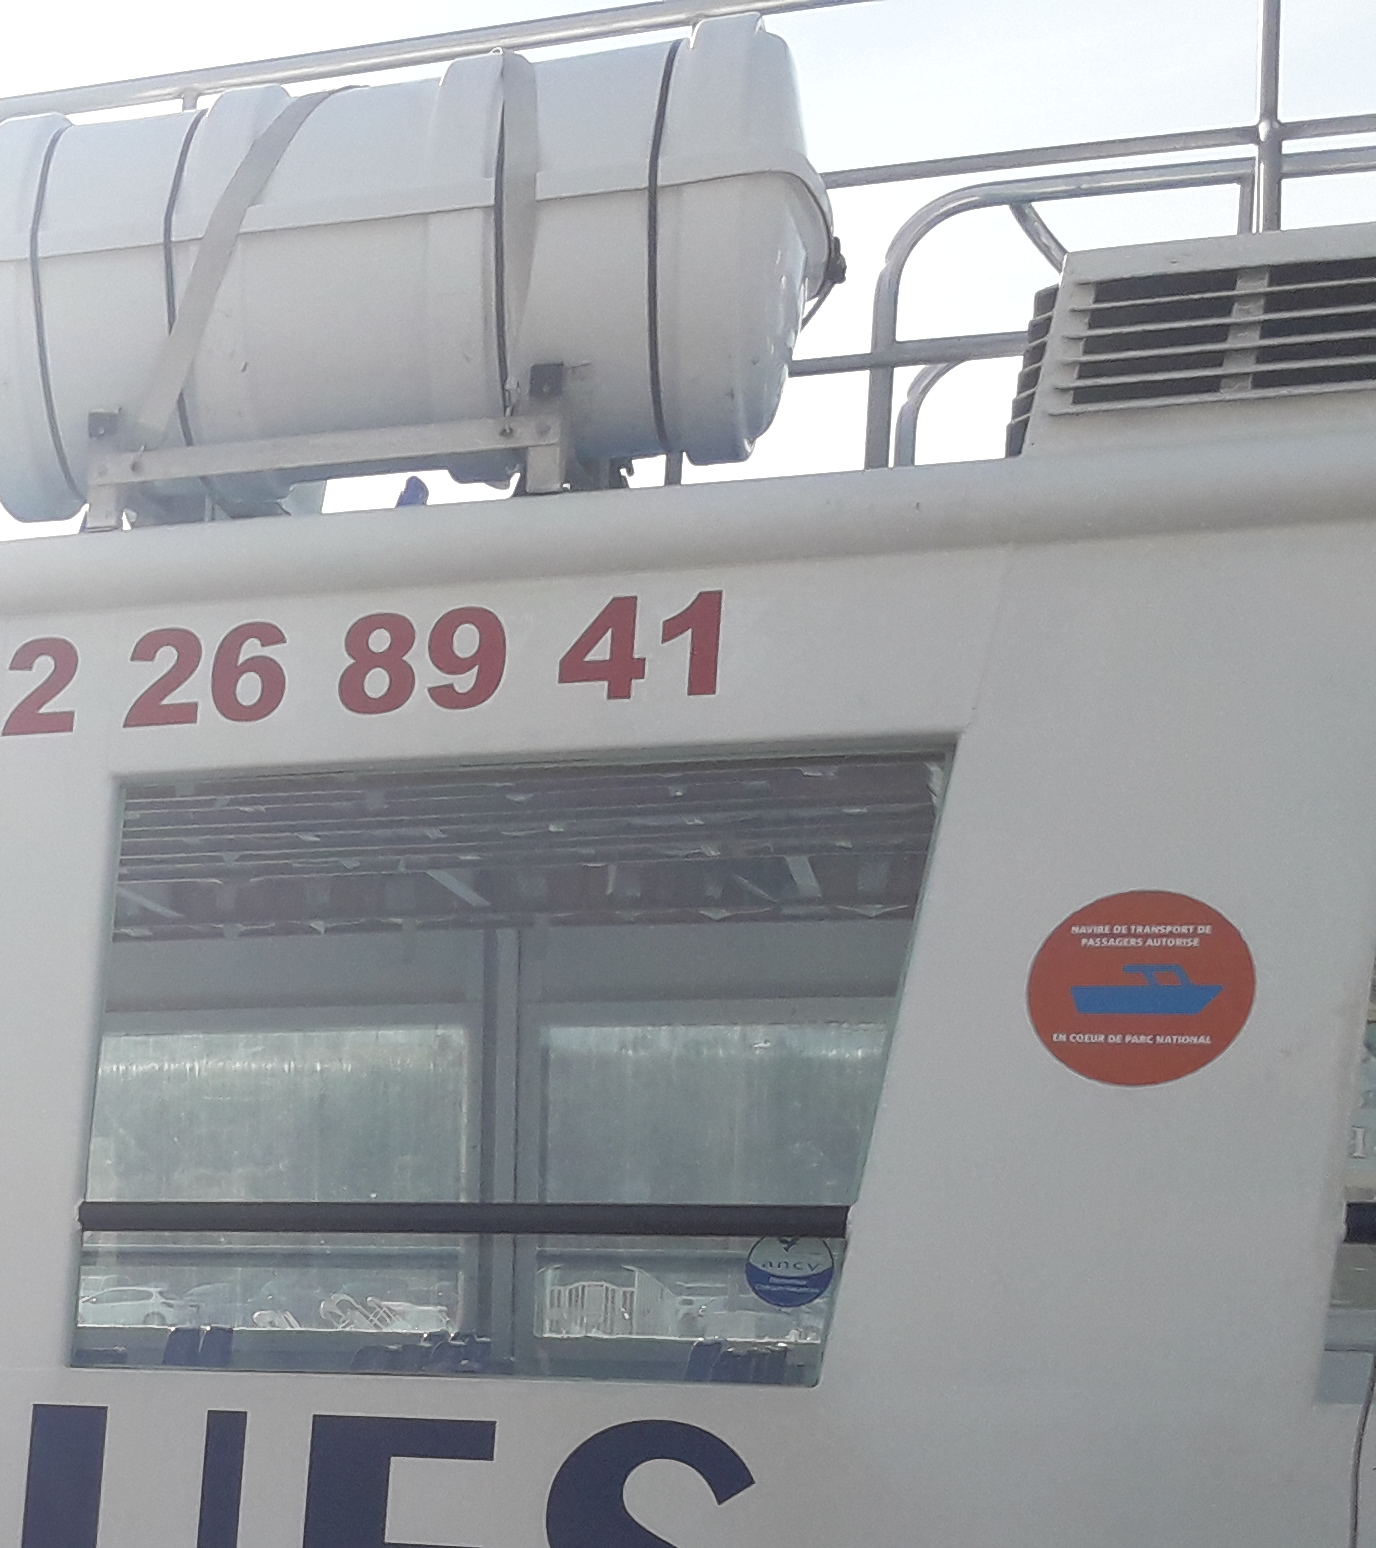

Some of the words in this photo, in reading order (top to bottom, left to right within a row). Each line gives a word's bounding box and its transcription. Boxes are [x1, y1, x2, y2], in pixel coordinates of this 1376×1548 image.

[122, 621, 287, 729] 26
[337, 606, 507, 714] 89
[558, 589, 724, 700] 41
[1071, 925, 1110, 934] NAVIRE
[1113, 925, 1128, 934] DE
[1130, 925, 1194, 934] TRANSPORT
[1197, 925, 1212, 934] DE
[1081, 938, 1143, 947] PASSAGERS
[1052, 1033, 1067, 1042] EN
[1069, 1033, 1105, 1043] COEUR
[1107, 1034, 1123, 1043] DE
[1125, 1034, 1154, 1044] PARC
[1156, 1035, 1212, 1045] NATIONAL
